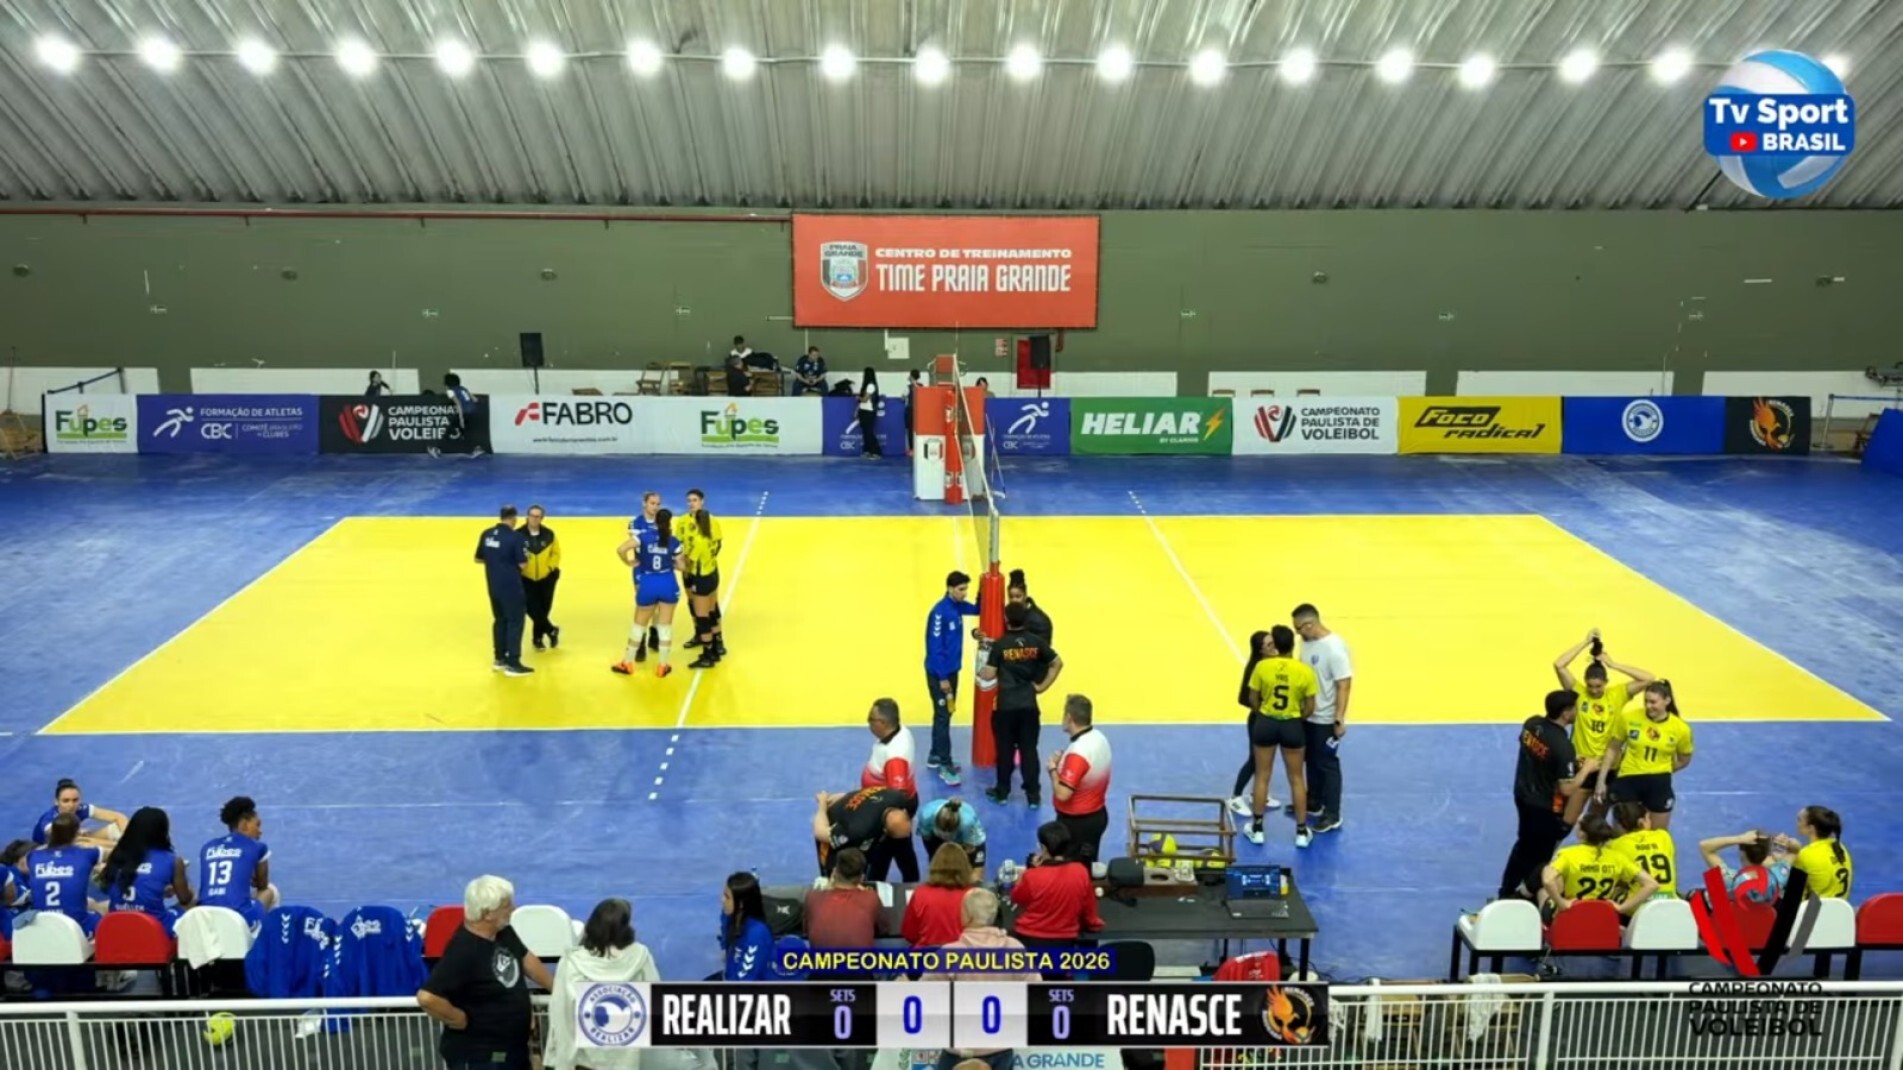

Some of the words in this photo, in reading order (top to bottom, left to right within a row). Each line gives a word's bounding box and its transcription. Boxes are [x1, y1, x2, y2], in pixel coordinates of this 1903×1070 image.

[875, 248, 935, 259] CENTRO
[939, 249, 958, 259] DE
[962, 248, 1072, 258] TREINAMENTO
[876, 264, 925, 292] TIME
[931, 264, 988, 292] PRAIA
[995, 264, 1071, 292] GRANDE
[200, 406, 250, 419] FORMAÇÃO
[251, 408, 263, 417] DE
[265, 407, 303, 416] ATLETAS
[542, 402, 633, 425] FABRO
[1301, 406, 1380, 416] CAMPEONATO
[56, 409, 128, 437] Fupes
[388, 416, 450, 427] PAULISTA
[701, 410, 780, 440] Fupes
[1080, 411, 1201, 435] HELIAR
[1301, 417, 1360, 427] PAULISTA
[1363, 417, 1380, 427] DE
[201, 423, 232, 439] CBC
[1301, 428, 1380, 440] VOLEIBOL
[653, 555, 662, 570] 8
[1272, 685, 1289, 711] 5
[1644, 746, 1658, 762] 11
[208, 860, 232, 886] 13
[45, 881, 60, 906] 2
[1028, 1053, 1105, 1069] GRANDE
